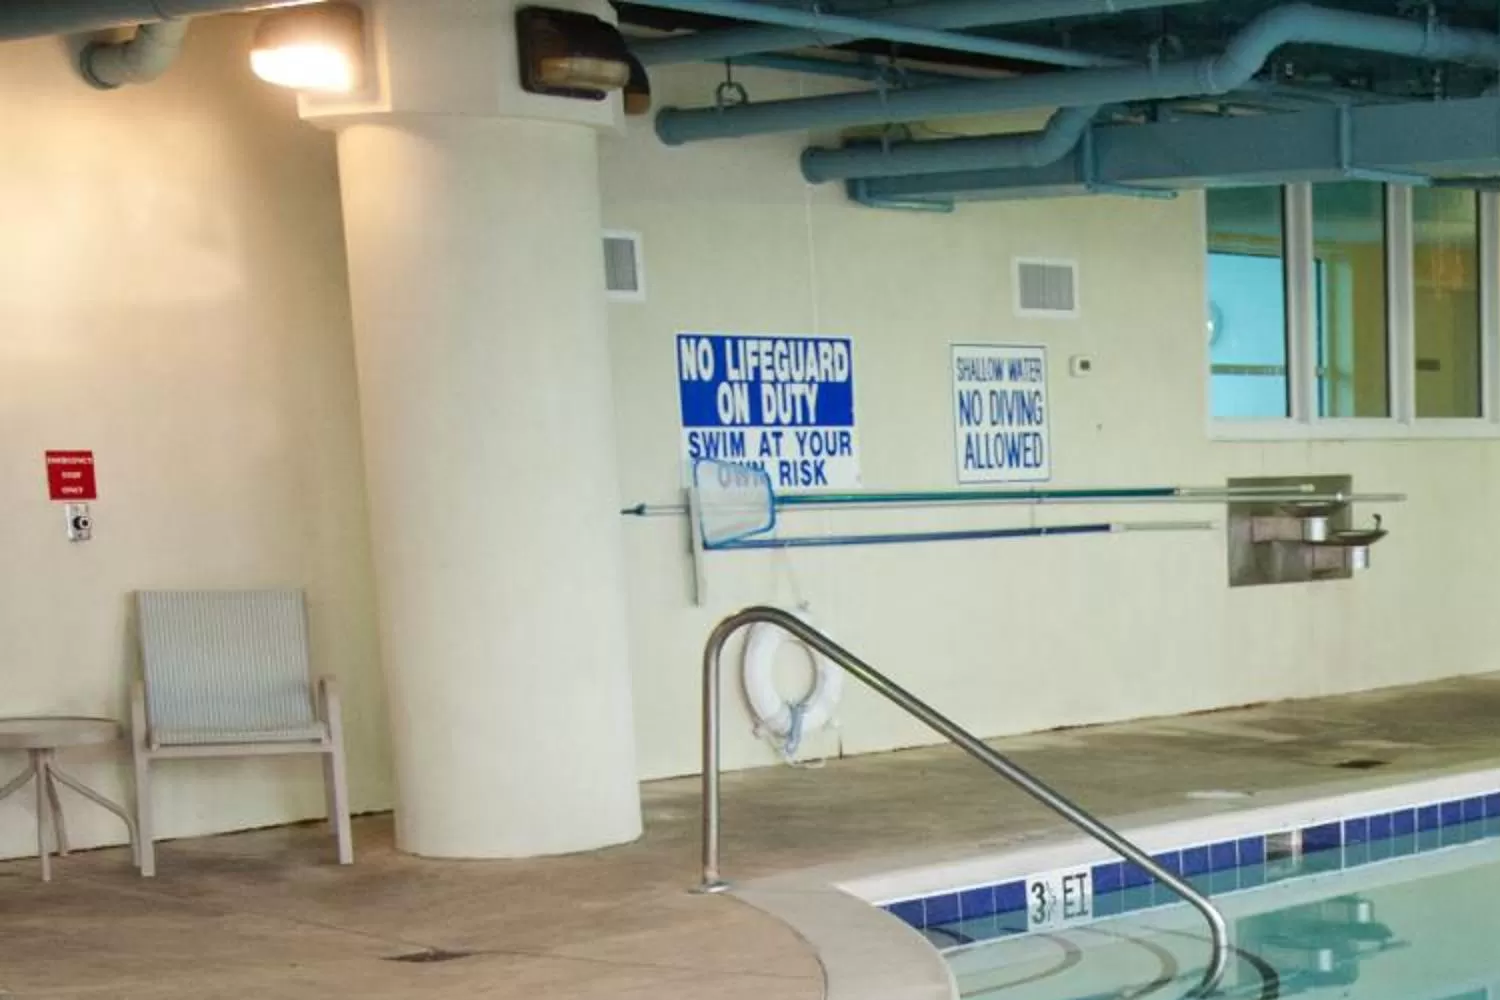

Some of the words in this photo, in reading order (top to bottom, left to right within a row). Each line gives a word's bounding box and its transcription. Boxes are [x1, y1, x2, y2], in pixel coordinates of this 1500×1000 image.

[680, 338, 714, 381] NO
[725, 339, 849, 382] LIFEGUARD
[956, 356, 1003, 382] SHALLOW
[1006, 357, 1043, 382] WATER
[717, 381, 750, 424] ON
[761, 382, 818, 425] DUTY
[959, 389, 982, 426] NO
[989, 389, 1043, 426] DIVING
[688, 430, 746, 458] SWIM
[759, 430, 783, 457] AT
[795, 430, 852, 457] YOUR
[964, 431, 1043, 470] ALLOWED
[779, 459, 828, 487] RISK
[1062, 872, 1087, 899] FT
